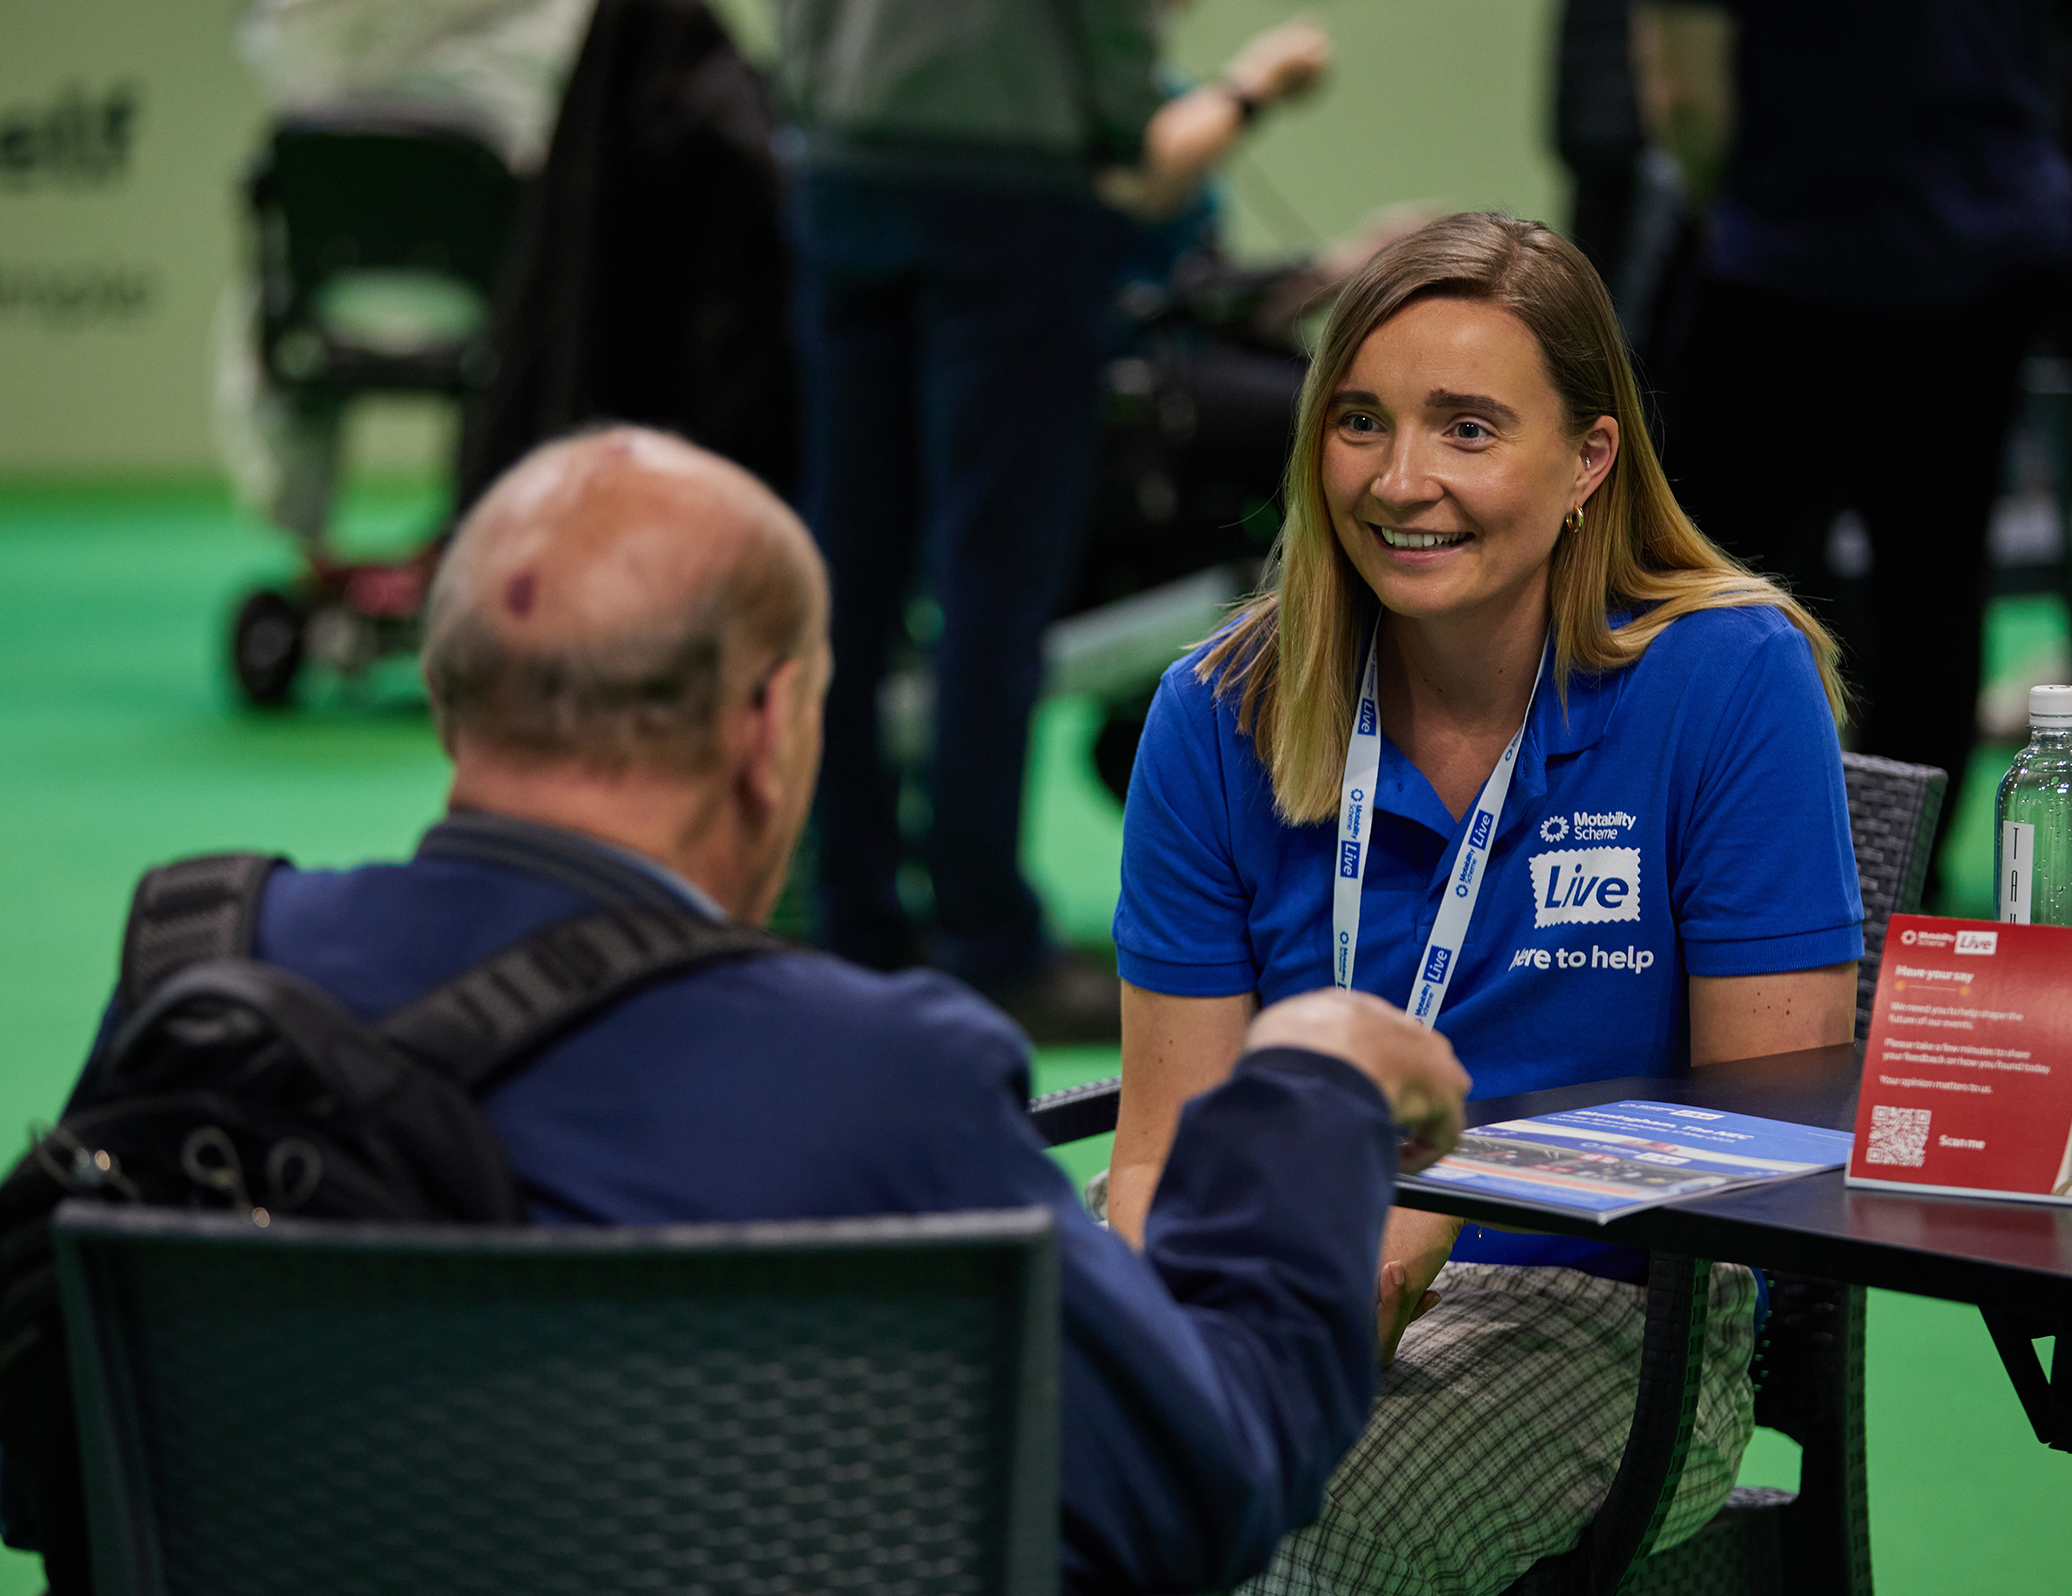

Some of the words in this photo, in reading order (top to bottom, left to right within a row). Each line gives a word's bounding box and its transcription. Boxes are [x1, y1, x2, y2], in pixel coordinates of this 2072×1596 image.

[1361, 701, 1374, 733] Live
[1347, 803, 1356, 831] Scheme
[1351, 804, 1363, 840] Motability
[1574, 811, 1637, 830] Motability
[1472, 814, 1491, 847] Live
[1574, 826, 1618, 840] Scheme
[1343, 843, 1357, 876] Live
[1459, 848, 1475, 881] Motability
[1465, 858, 1477, 884] Scheme
[1544, 863, 1629, 909] Live
[1960, 935, 1993, 950] Live
[1427, 950, 1448, 981] Live
[1556, 948, 1587, 969] to
[1591, 945, 1654, 974] help
[1895, 965, 1925, 978] Have
[1926, 970, 1952, 981] your
[1953, 972, 1974, 984] say
[1415, 983, 1432, 1016] Motability
[1907, 1002, 1930, 1014] need
[1931, 1006, 1947, 1017] you
[1948, 1005, 1958, 1016] to
[1959, 1006, 1977, 1020] help
[1980, 1008, 2006, 1022] shape
[2008, 1010, 2023, 1022] the
[1888, 1013, 1914, 1025] future
[1916, 1016, 1927, 1026] of
[1884, 1037, 1913, 1050] Please
[1915, 1040, 1933, 1051] take
[1942, 1042, 1959, 1054] few
[1960, 1043, 1993, 1057] minutes
[1995, 1047, 2005, 1058] to
[2007, 1048, 2031, 1060] share
[1905, 1051, 1943, 1064] feedback
[1945, 1056, 1956, 1065] on
[1957, 1055, 1977, 1067] how
[1978, 1059, 1996, 1070] you
[1997, 1059, 2022, 1071] found
[1879, 1074, 1899, 1085] Your
[1900, 1077, 1934, 1090] opinion
[1936, 1079, 1968, 1092] matters
[1969, 1082, 1979, 1093] to
[1938, 1134, 1967, 1149] Scan
[1969, 1139, 1986, 1150] me
